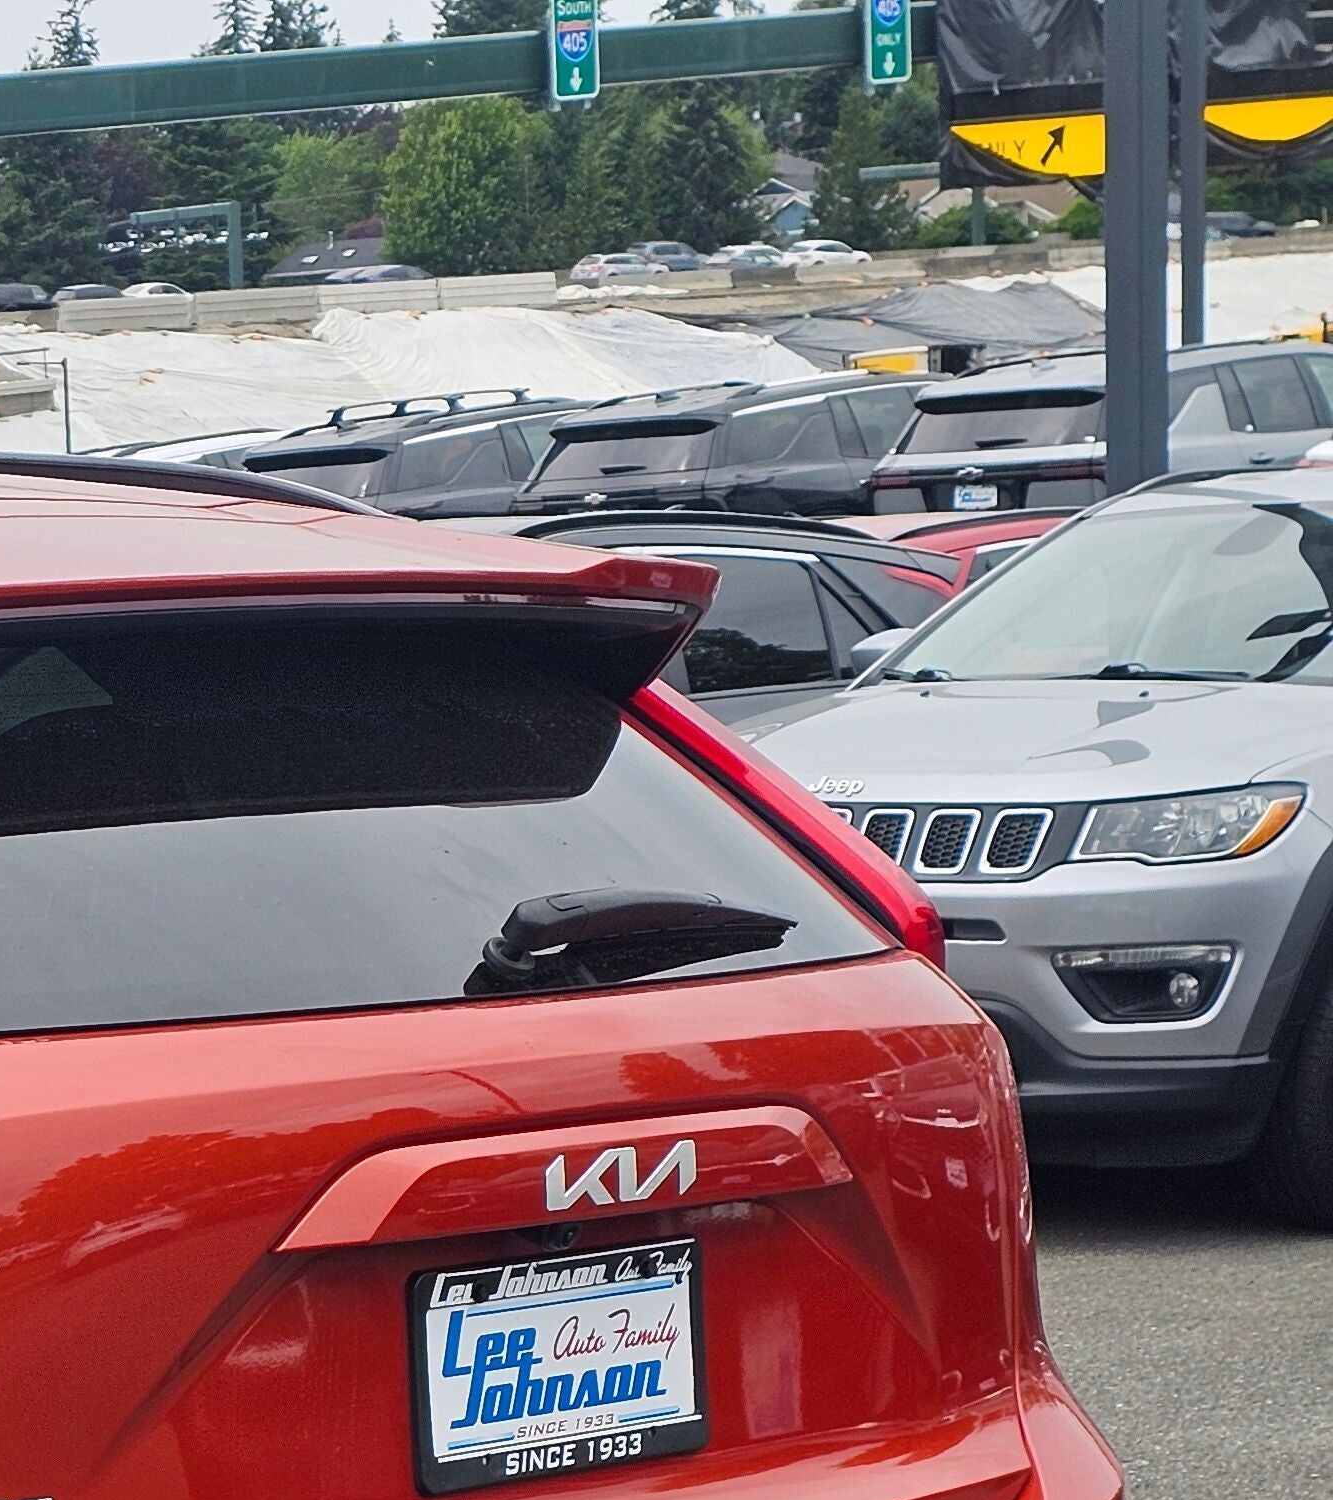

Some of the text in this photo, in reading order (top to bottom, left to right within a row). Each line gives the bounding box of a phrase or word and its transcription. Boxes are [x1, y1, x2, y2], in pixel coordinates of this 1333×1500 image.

[557, 0, 591, 16] SOUTH
[878, 0, 900, 17] 405
[563, 32, 587, 51] 405
[808, 775, 865, 797] Jeep
[545, 1139, 698, 1212] KIA
[488, 1261, 609, 1301] Johnson
[441, 1302, 681, 1378] Lee Auto Family
[449, 1343, 668, 1430] Johnson
[516, 1412, 616, 1439] SINCE 1933
[505, 1432, 643, 1476] SINCE 1933
